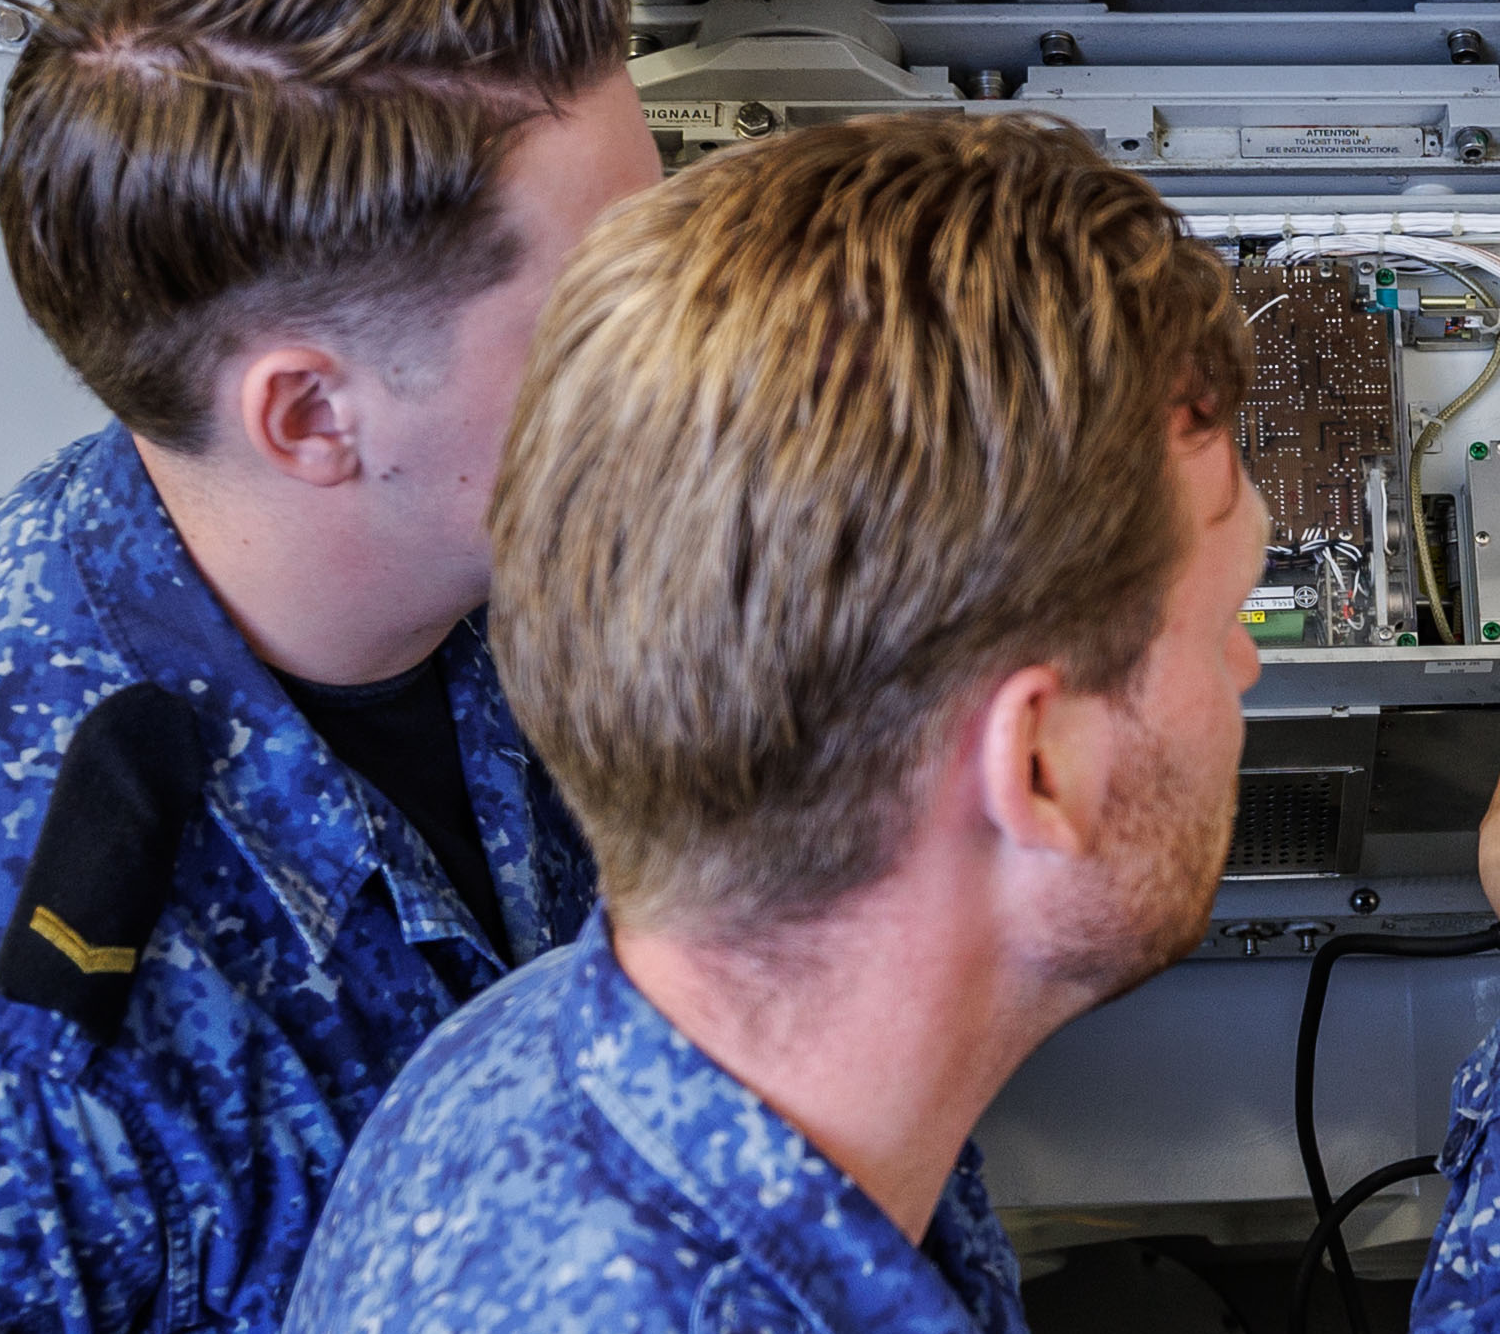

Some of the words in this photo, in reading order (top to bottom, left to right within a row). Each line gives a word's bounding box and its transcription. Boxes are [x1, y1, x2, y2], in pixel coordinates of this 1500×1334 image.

[643, 109, 712, 119] SIGNAAL
[1306, 129, 1360, 138] ATTENTION
[1265, 146, 1282, 154] SEE
[1283, 146, 1340, 154] INSTALLATION
